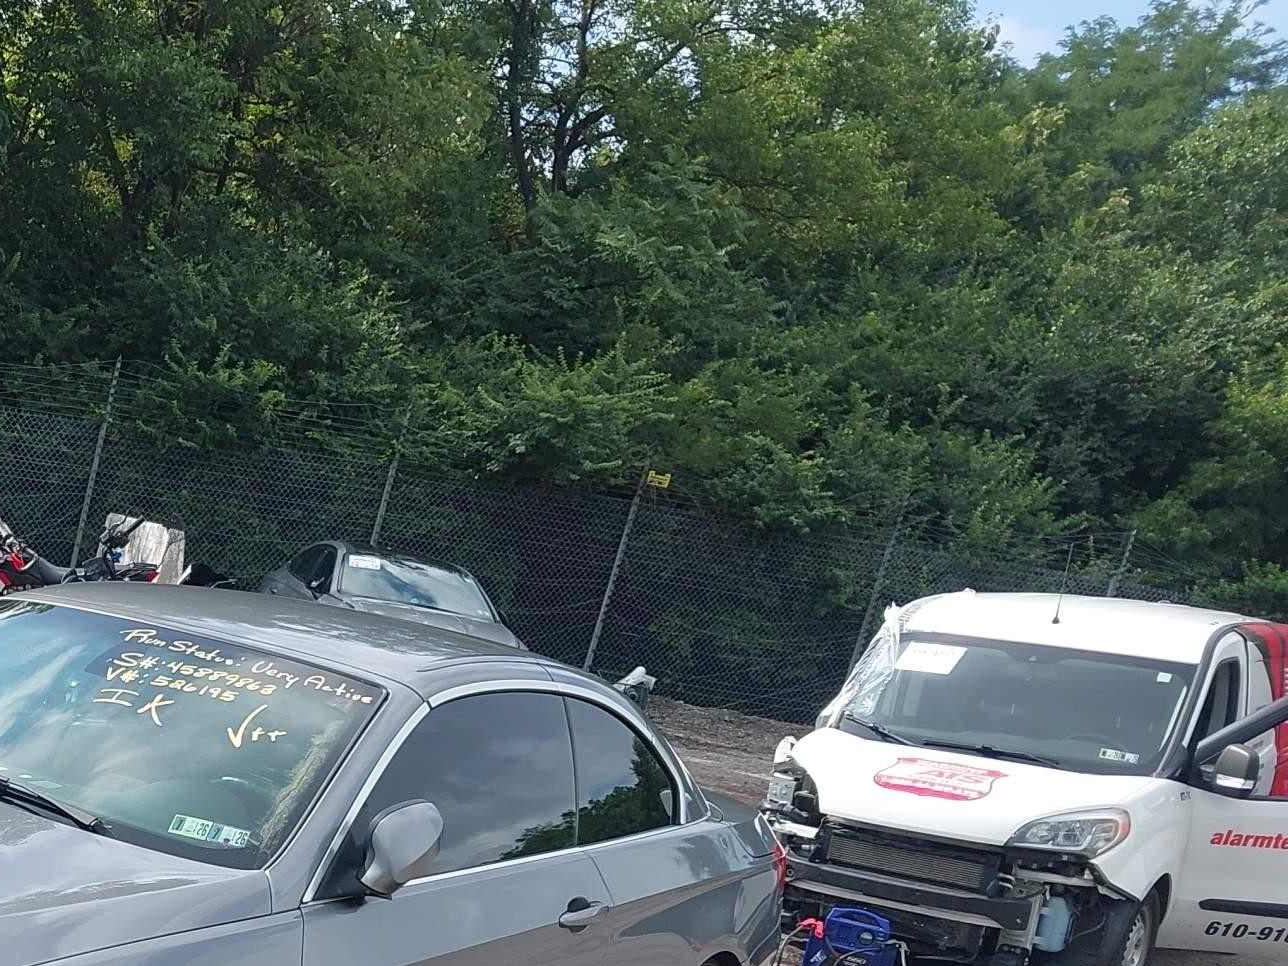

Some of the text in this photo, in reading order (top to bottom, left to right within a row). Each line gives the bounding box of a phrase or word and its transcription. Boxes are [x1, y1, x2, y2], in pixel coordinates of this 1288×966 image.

[120, 629, 166, 646] Run
[251, 660, 300, 689] Very
[303, 675, 373, 704] Active
[167, 661, 277, 695] 45889863
[1205, 921, 1288, 943] 610-91
